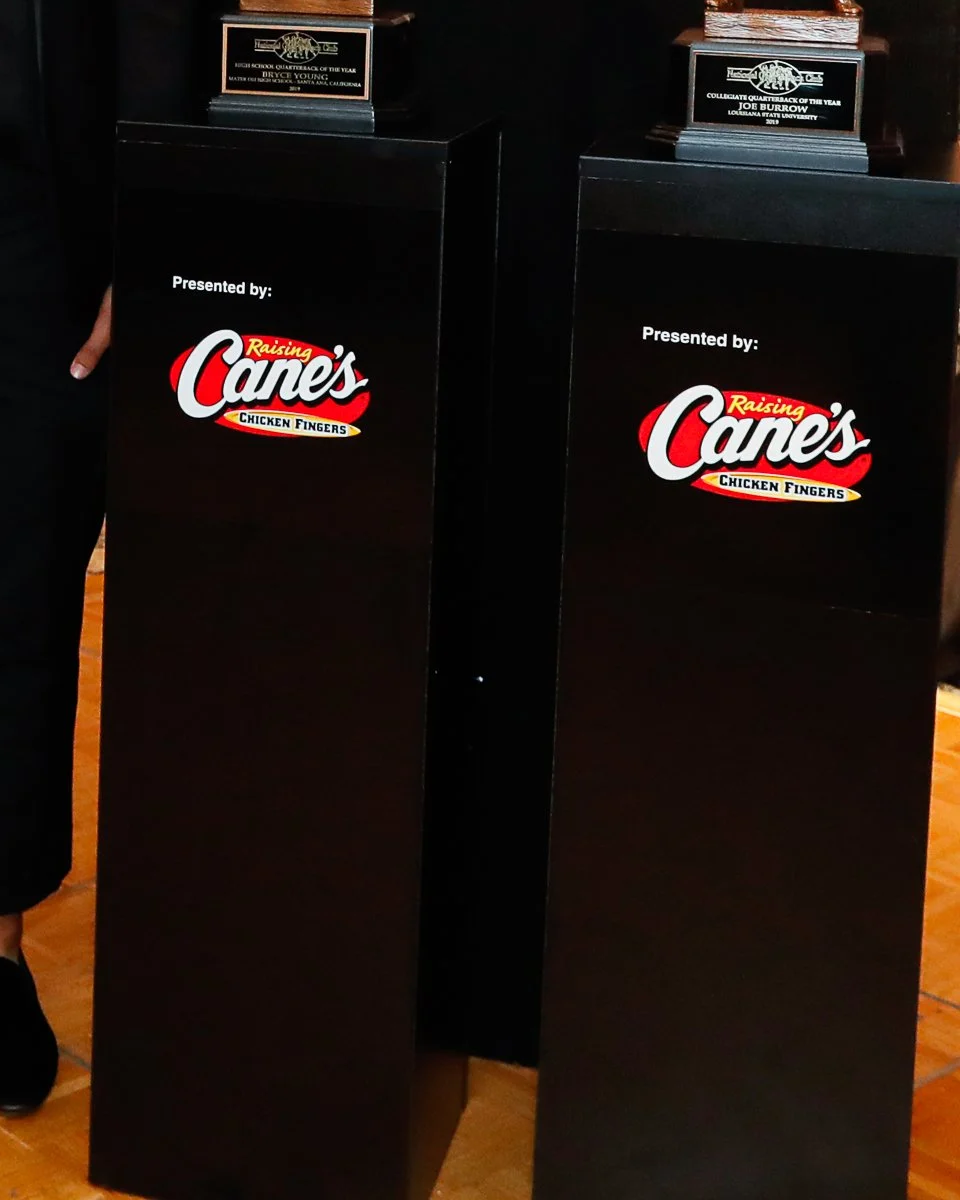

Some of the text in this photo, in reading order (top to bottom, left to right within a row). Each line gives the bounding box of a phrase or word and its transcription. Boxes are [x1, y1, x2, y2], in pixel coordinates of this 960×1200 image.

[262, 71, 329, 81] BRYCE YOUNG
[275, 64, 319, 72] QUARTERBACK
[706, 92, 748, 100] COLLEGIATE
[748, 94, 799, 104] QUARTERBACK
[738, 102, 809, 113] JOE BURROW
[172, 275, 273, 299] Presented by:
[246, 338, 313, 363] Raising
[642, 326, 759, 352] Presented by:
[177, 329, 369, 419] Cane's
[727, 394, 806, 422] Raising
[239, 412, 347, 435] CHICKEN FINGERS
[647, 384, 871, 481] Cane's
[719, 474, 845, 500] CHICKEN FINGERS
